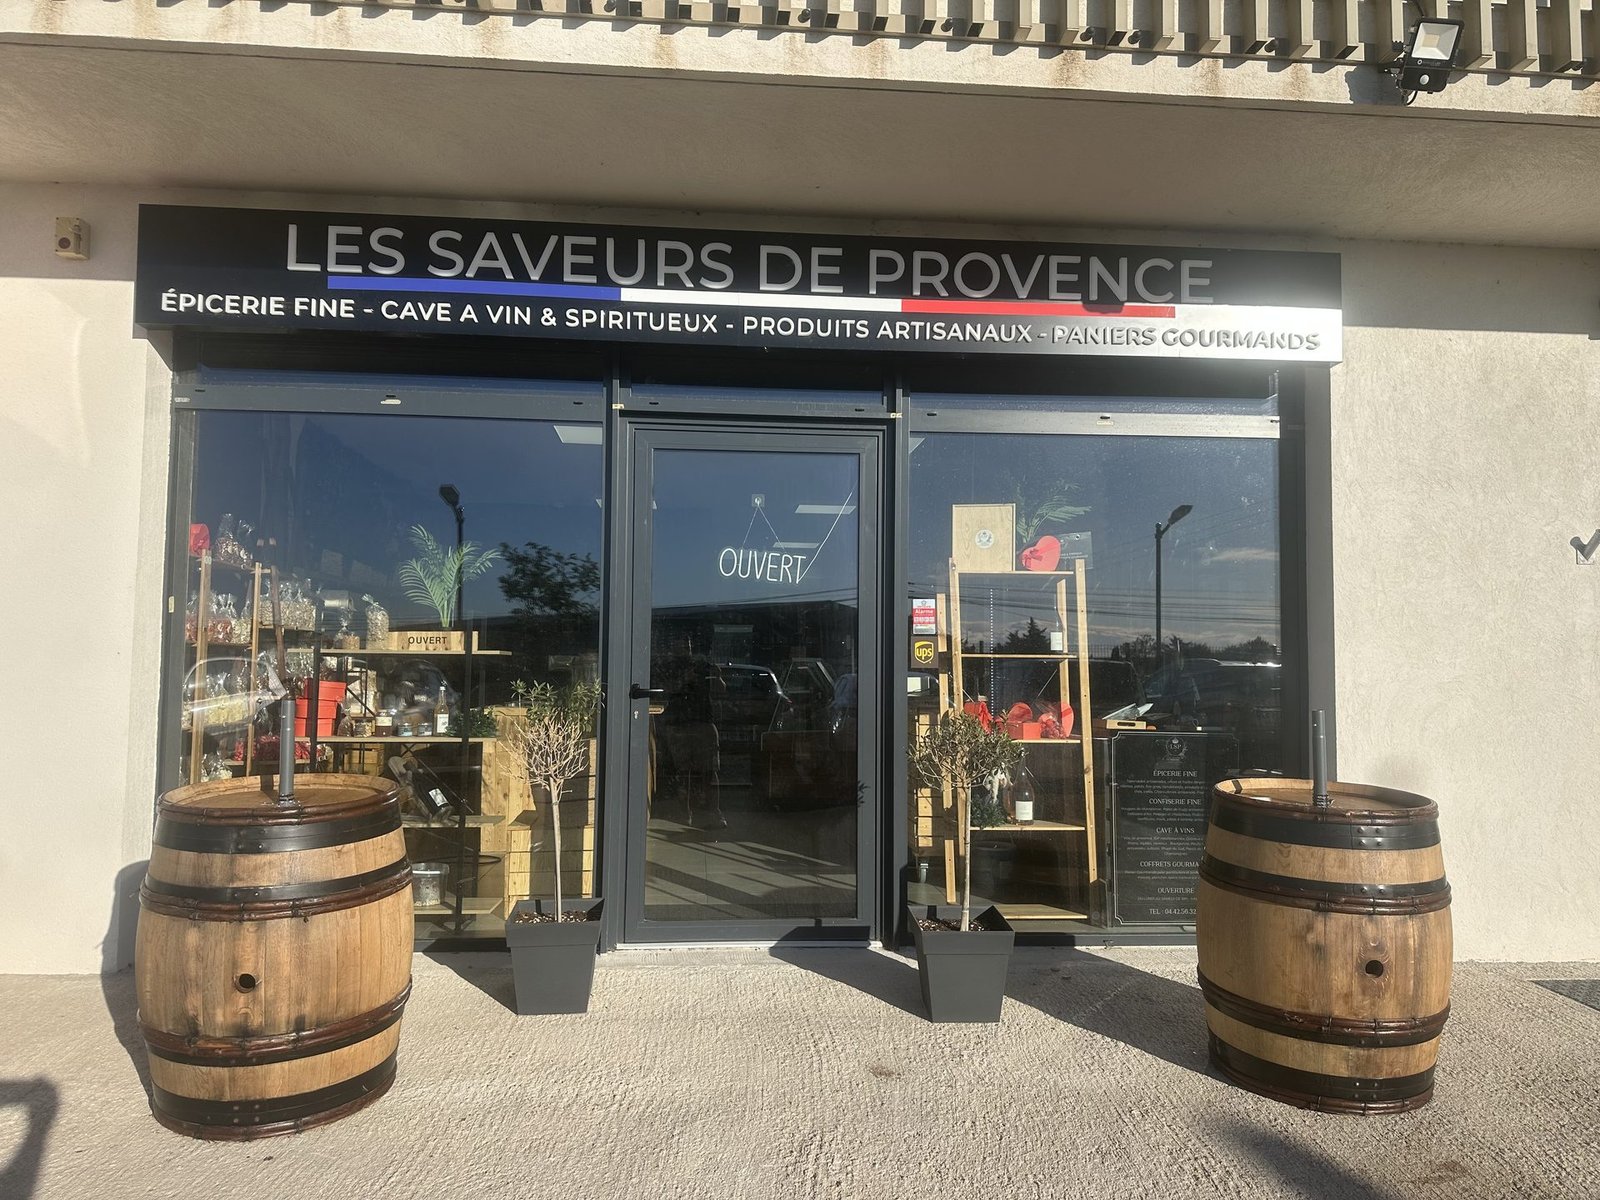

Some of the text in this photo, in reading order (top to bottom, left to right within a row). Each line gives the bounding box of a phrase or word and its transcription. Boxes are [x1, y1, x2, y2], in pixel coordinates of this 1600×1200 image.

[287, 224, 1214, 303] LES SAVEURS DE PROVENCE
[161, 288, 285, 317] ÉPICERIE
[294, 297, 355, 318] FINE
[381, 300, 451, 322] CAVE
[459, 304, 478, 324] A
[486, 304, 531, 326] VIN
[540, 307, 557, 327] &
[565, 309, 718, 333] SPIRITUEUX
[743, 316, 870, 338] PRODUITS
[876, 320, 1033, 343] ARTISANAUX
[1051, 325, 1156, 346] PANIERS
[1161, 328, 1321, 350] GOURMANDS
[720, 548, 807, 584] OUVERT
[408, 636, 447, 645] OUVERT
[916, 647, 932, 660] ups
